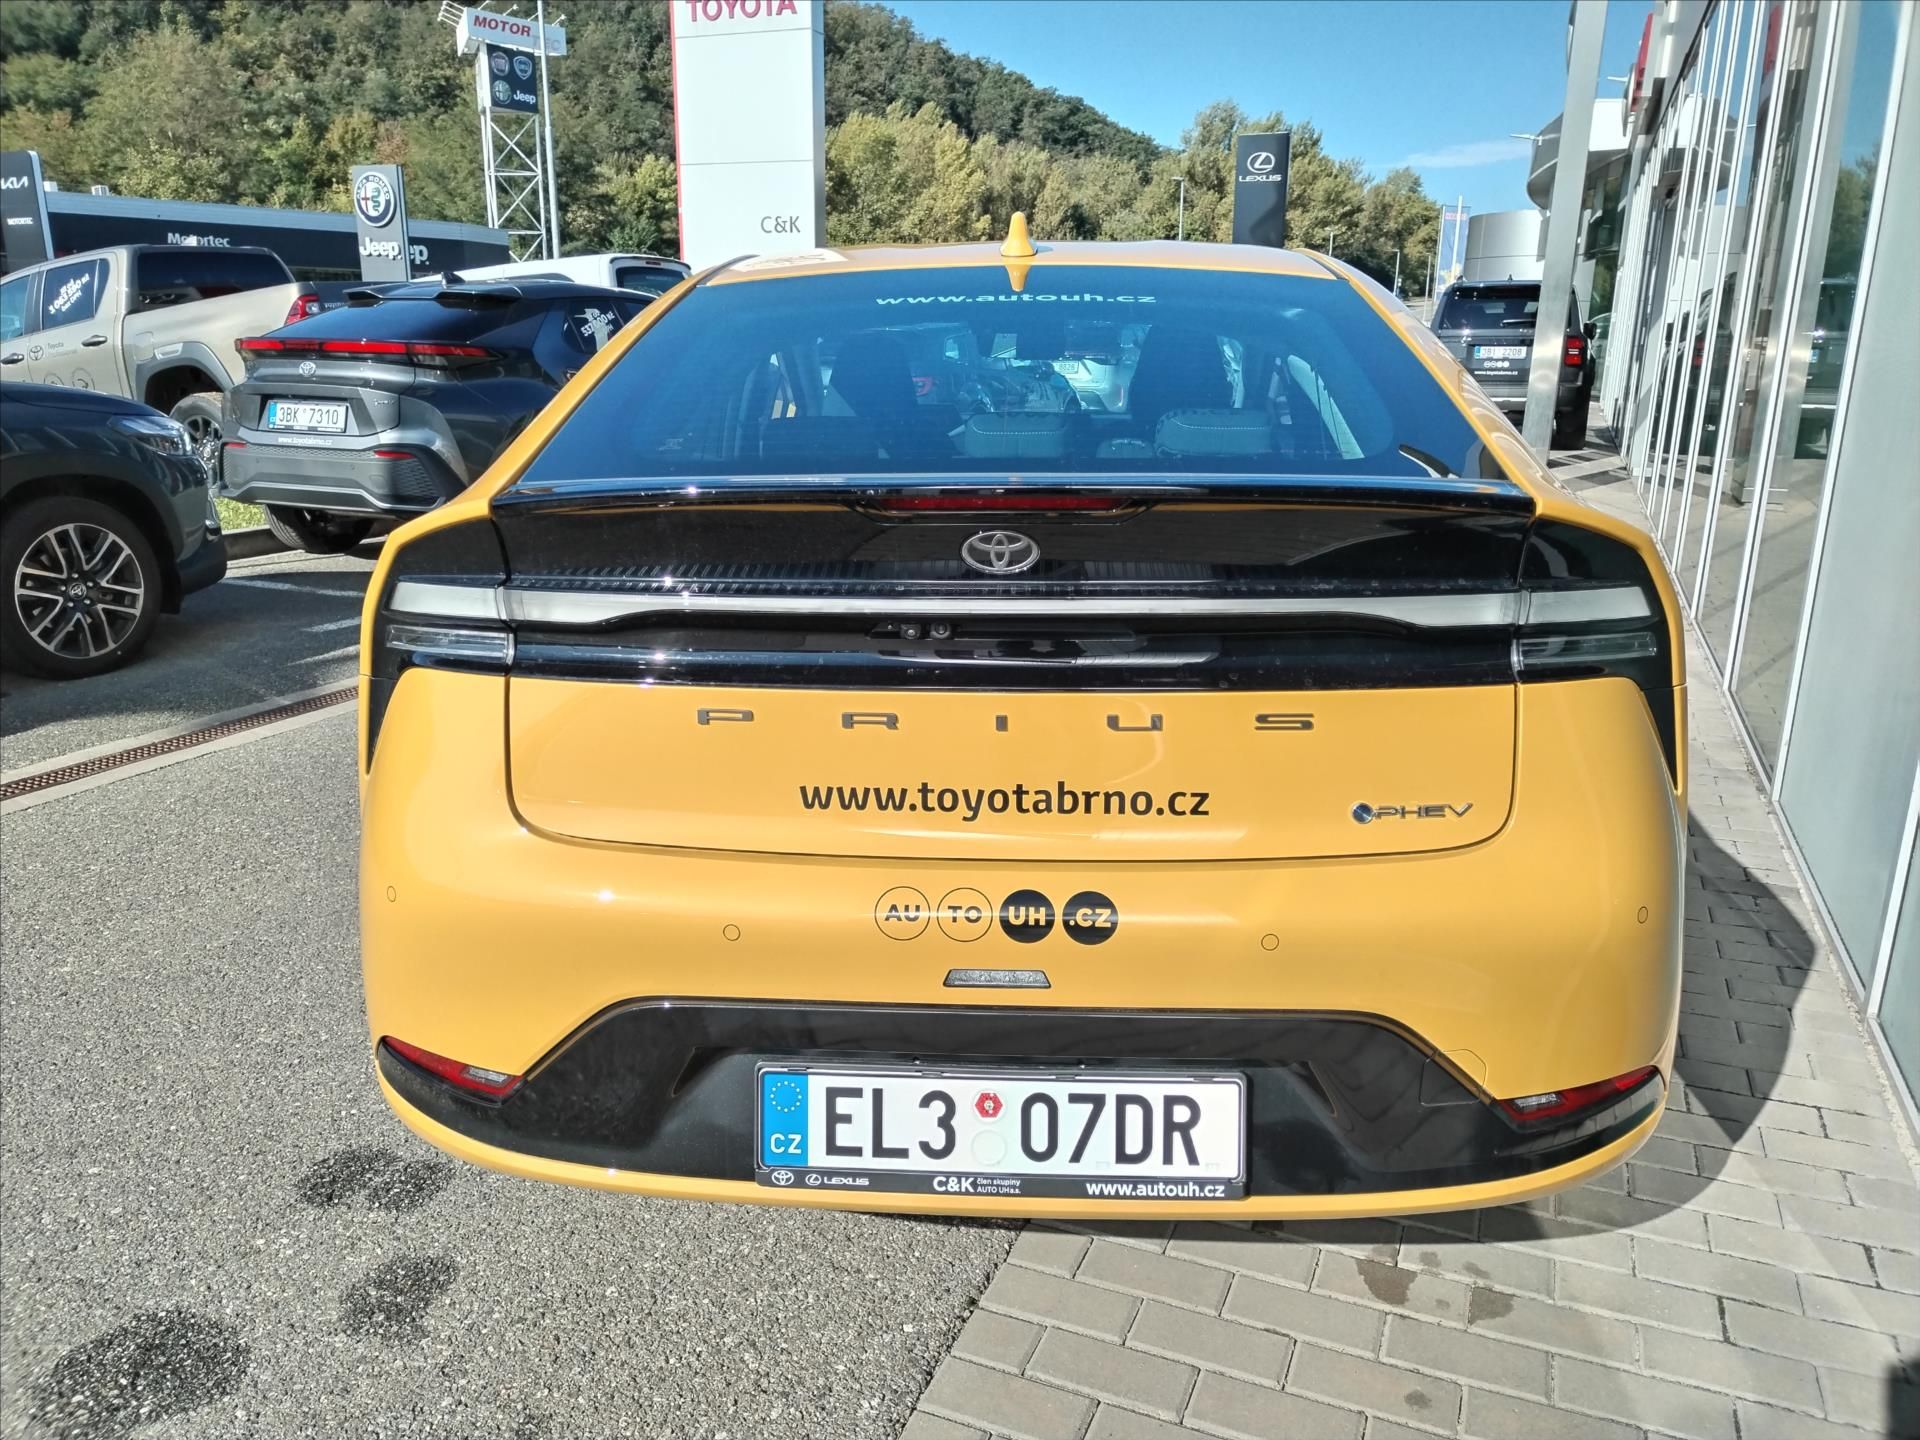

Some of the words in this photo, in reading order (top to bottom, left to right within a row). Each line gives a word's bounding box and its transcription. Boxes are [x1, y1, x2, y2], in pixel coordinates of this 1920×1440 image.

[686, 0, 798, 22] TOYOTA
[473, 15, 531, 37] MOTOR
[513, 90, 536, 104] Jeep
[760, 215, 801, 233] C&K
[875, 293, 1157, 305] www.autouh.cz
[279, 406, 301, 423] 3BK
[308, 408, 339, 425] 7310
[697, 708, 1314, 731] PRIUS
[800, 781, 1210, 822] www.toyotabrno.cz
[825, 1087, 956, 1160] EL3
[1021, 1092, 1201, 1166] 07DR
[770, 1133, 802, 1154] CZ
[824, 1176, 869, 1186] LEXUS
[933, 1176, 975, 1193] C&K
[993, 1179, 1020, 1187] skupiny
[1086, 1181, 1225, 1198] www.autouh.cz
